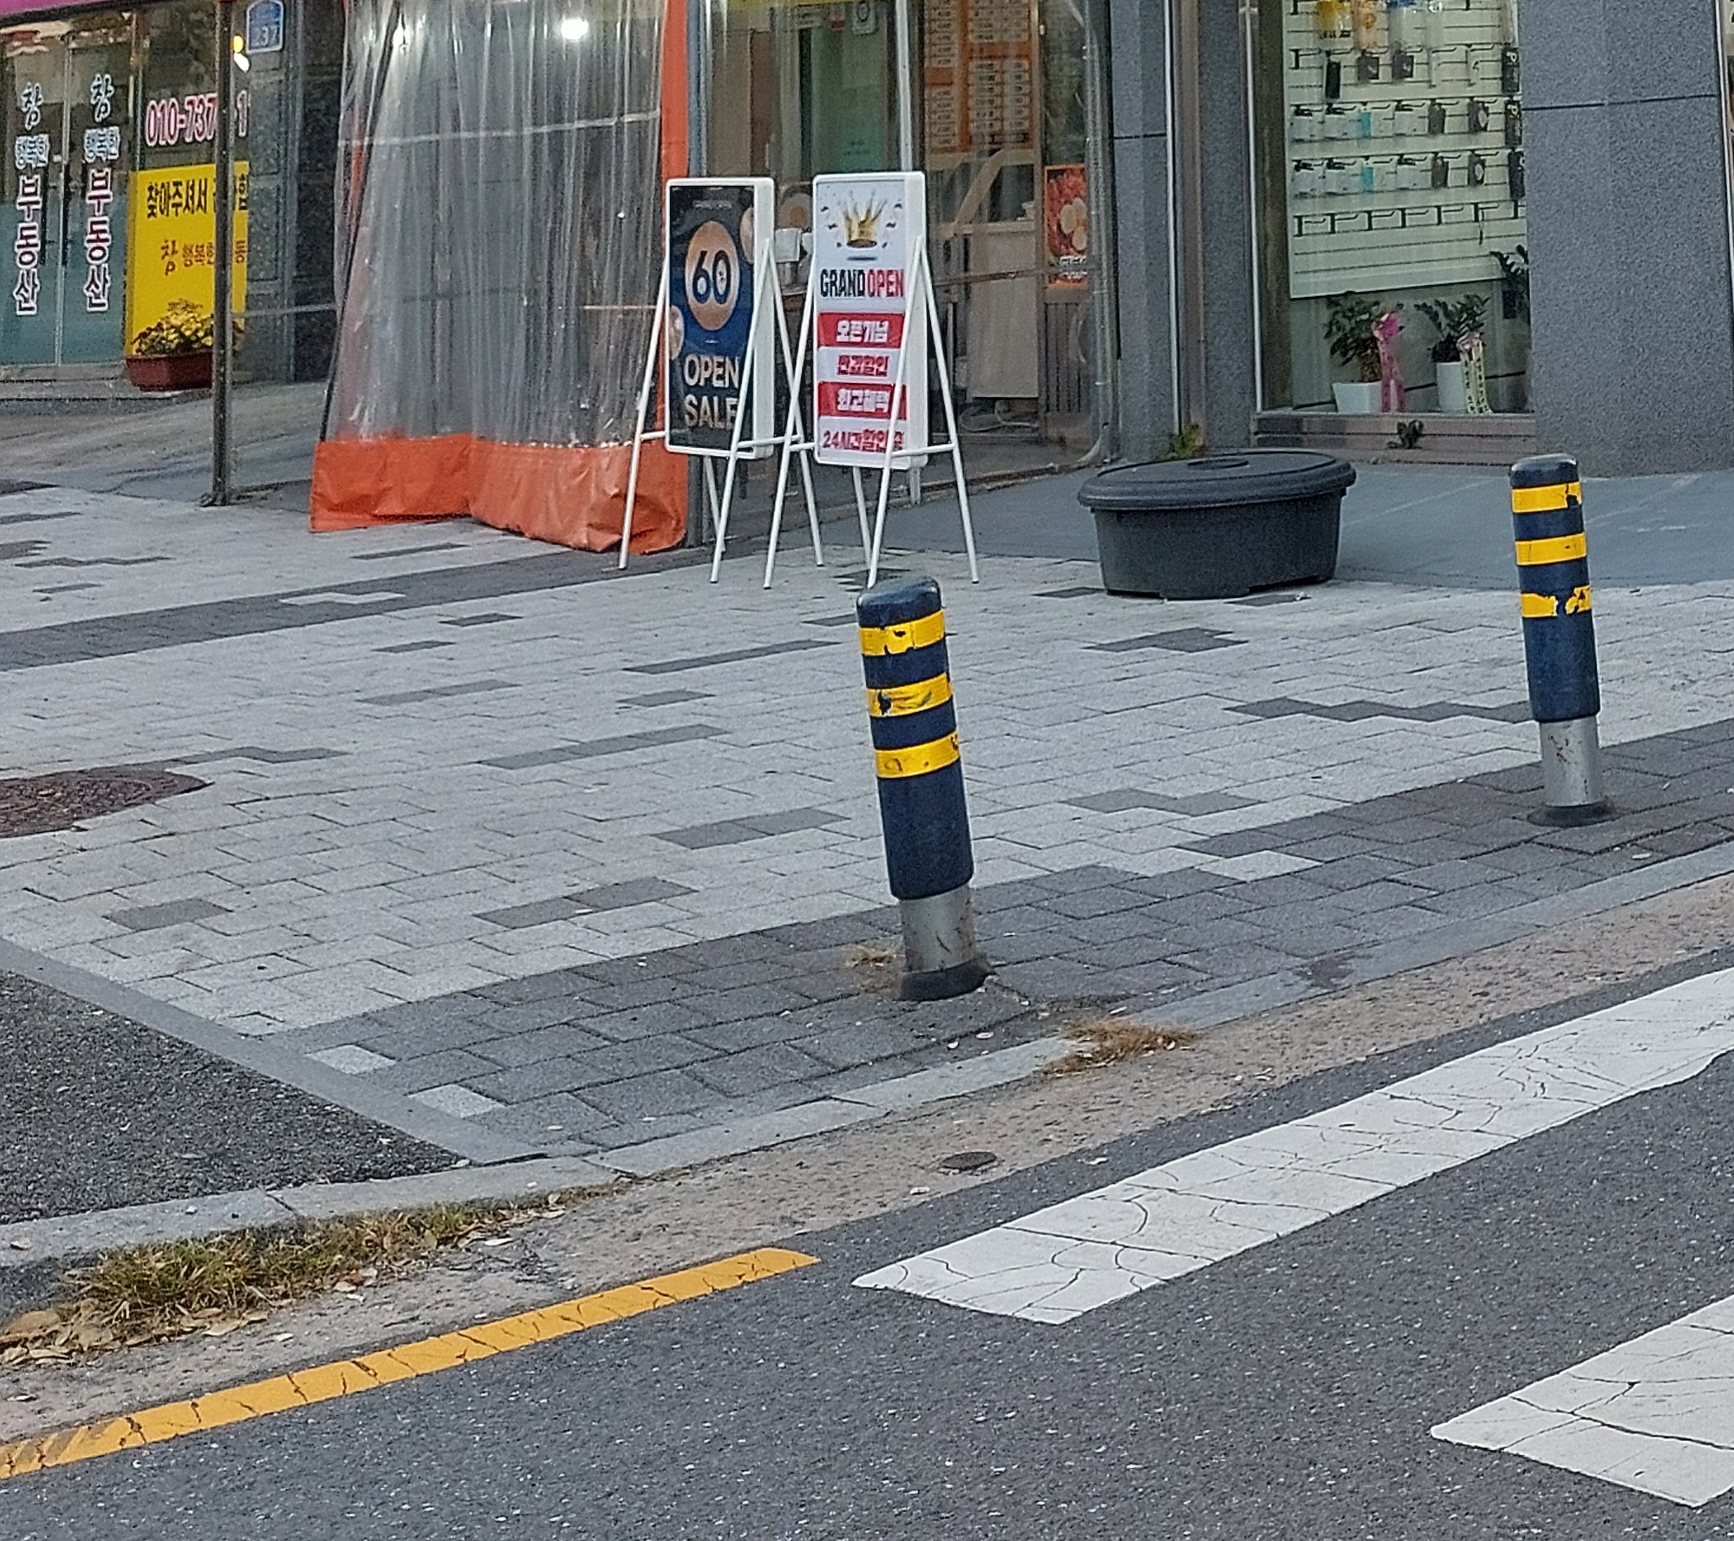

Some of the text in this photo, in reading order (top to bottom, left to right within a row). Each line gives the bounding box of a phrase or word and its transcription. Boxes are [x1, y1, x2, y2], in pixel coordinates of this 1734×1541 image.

[14, 174, 43, 317] 부동산
[84, 167, 114, 313] 부동산
[692, 250, 731, 305] 60
[820, 269, 905, 297] GRAND OPEN
[684, 353, 739, 388] OPEN
[684, 393, 739, 430] SALE
